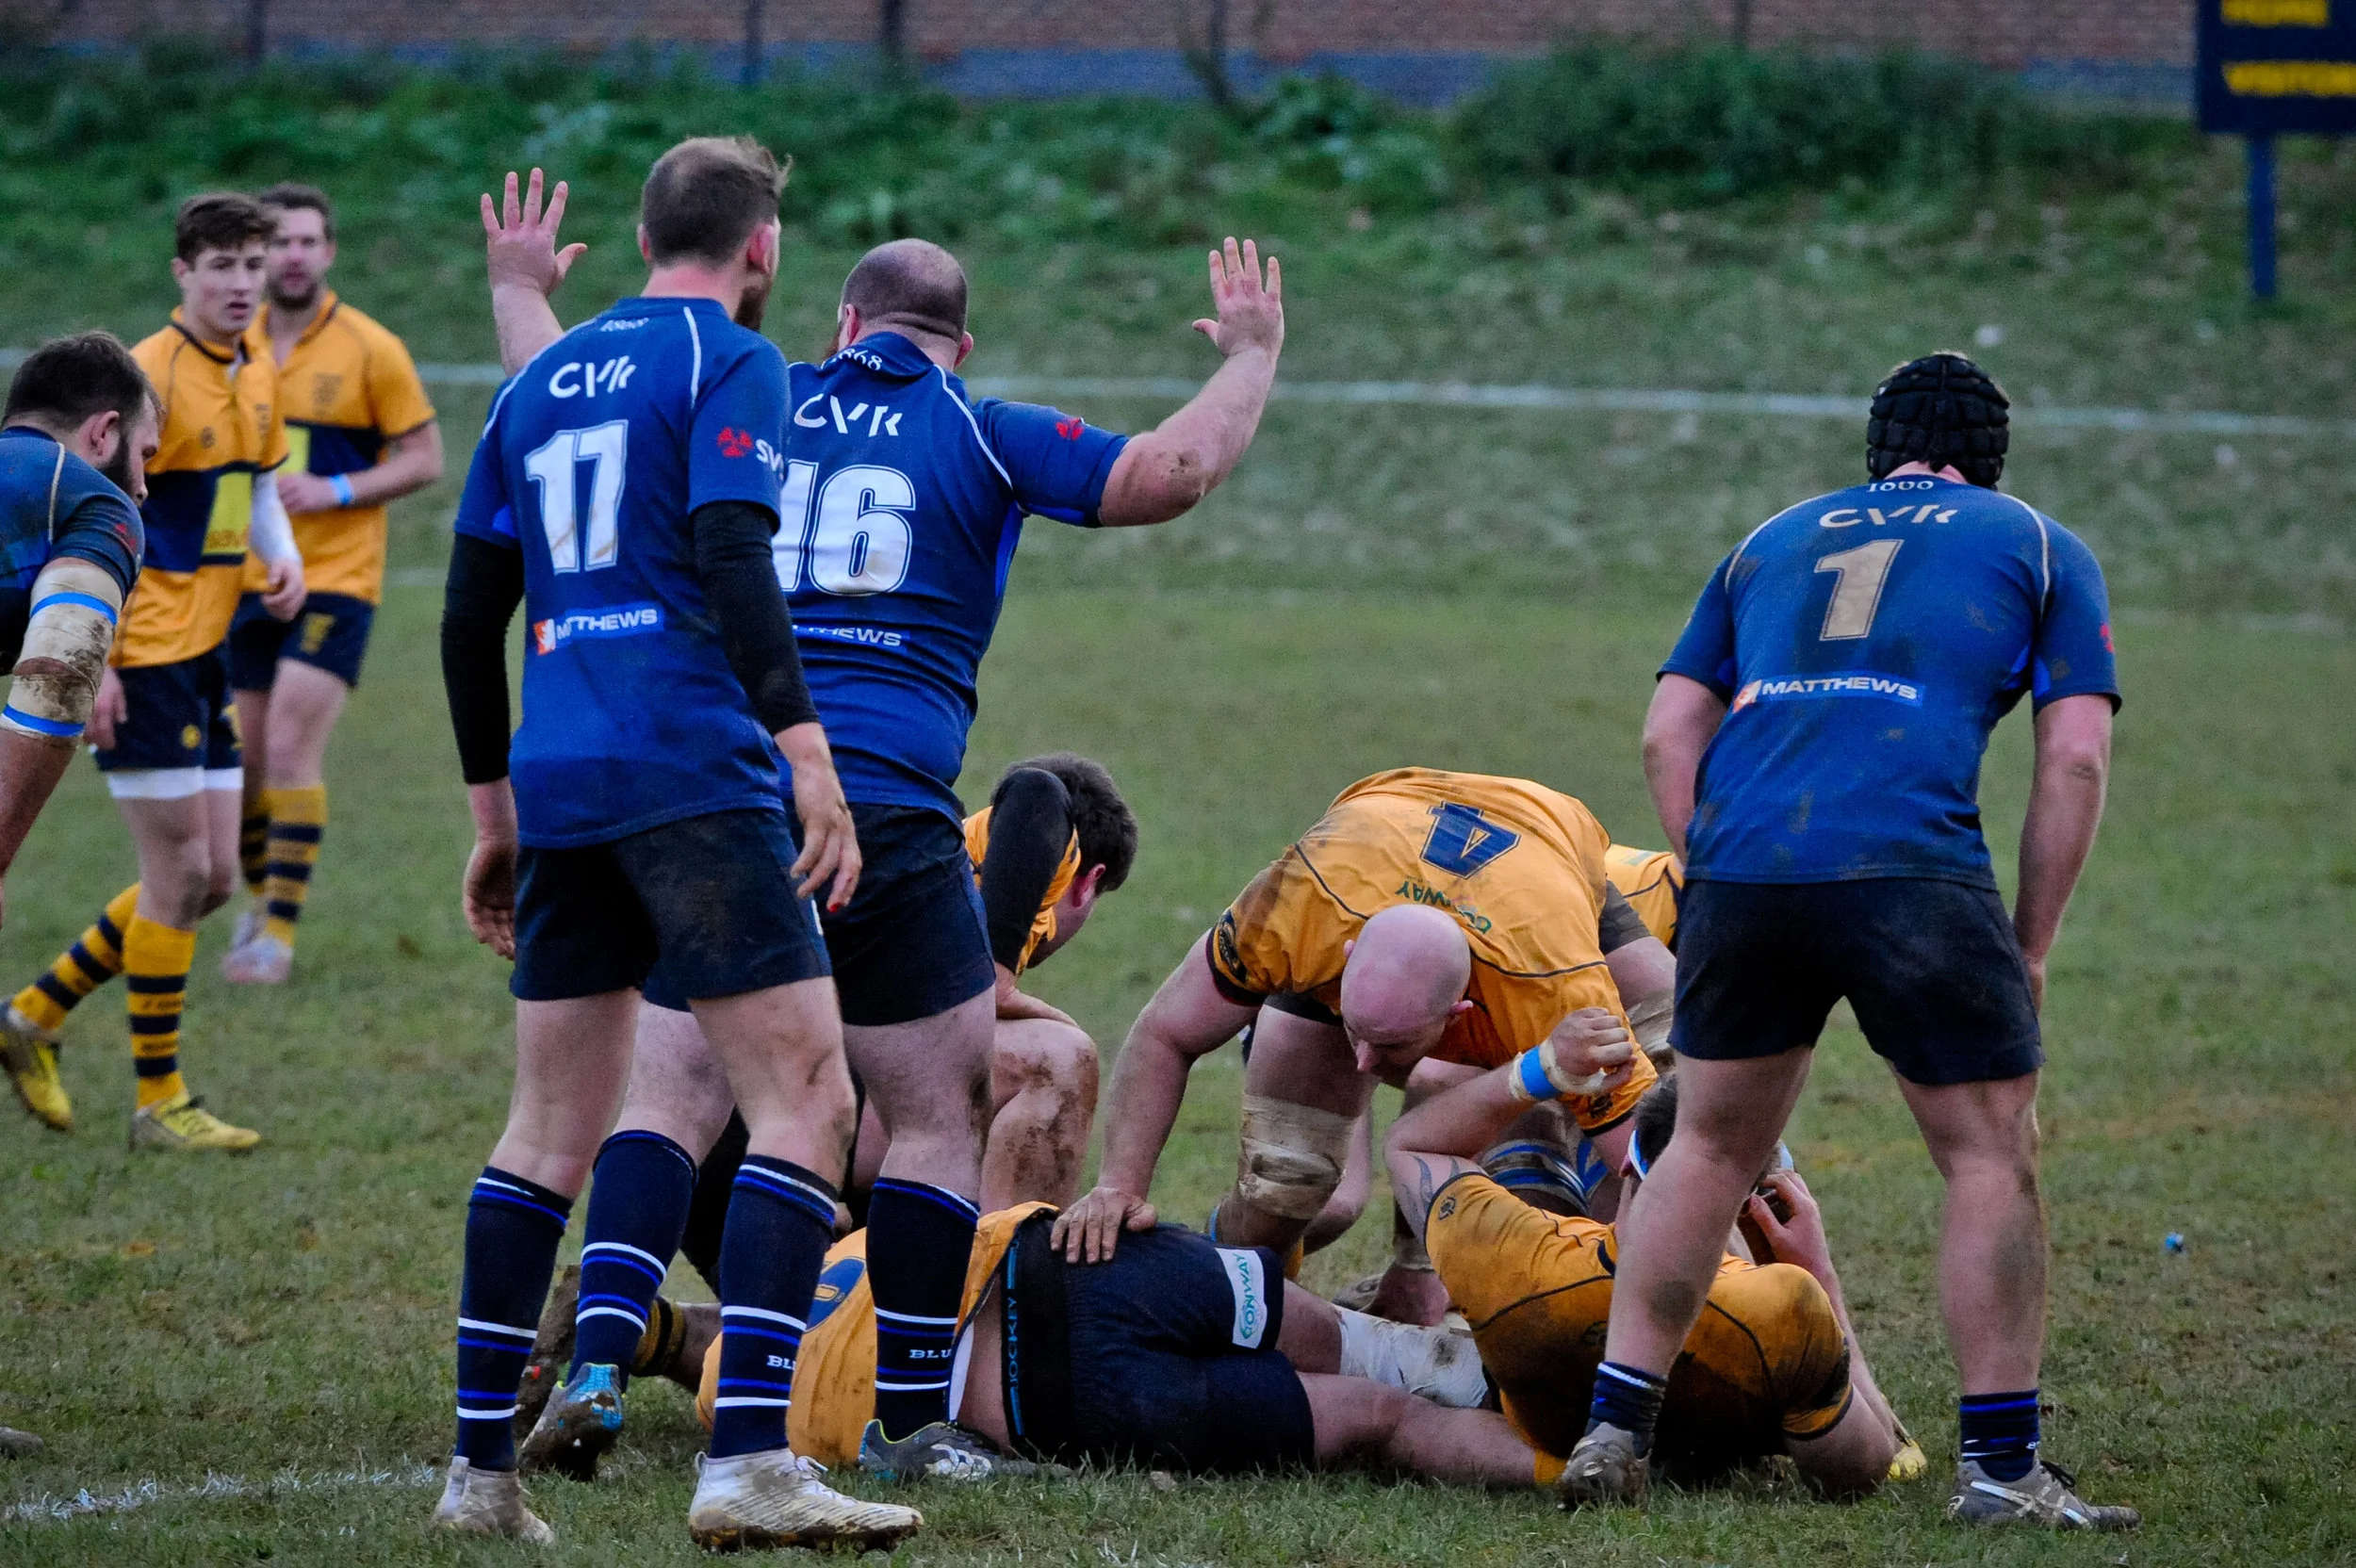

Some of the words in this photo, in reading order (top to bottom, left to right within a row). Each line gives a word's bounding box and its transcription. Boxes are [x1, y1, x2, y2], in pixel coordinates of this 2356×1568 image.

[794, 393, 903, 437] CVR
[524, 418, 630, 576] 17
[773, 458, 916, 596] 16
[1819, 504, 1958, 529] CVR
[1813, 538, 1905, 642] 1
[1761, 677, 1919, 700] MATTHEWS
[1419, 799, 1522, 880] 4
[1233, 1252, 1255, 1339] CONWAY
[1007, 1297, 1020, 1388] JOCKEY
